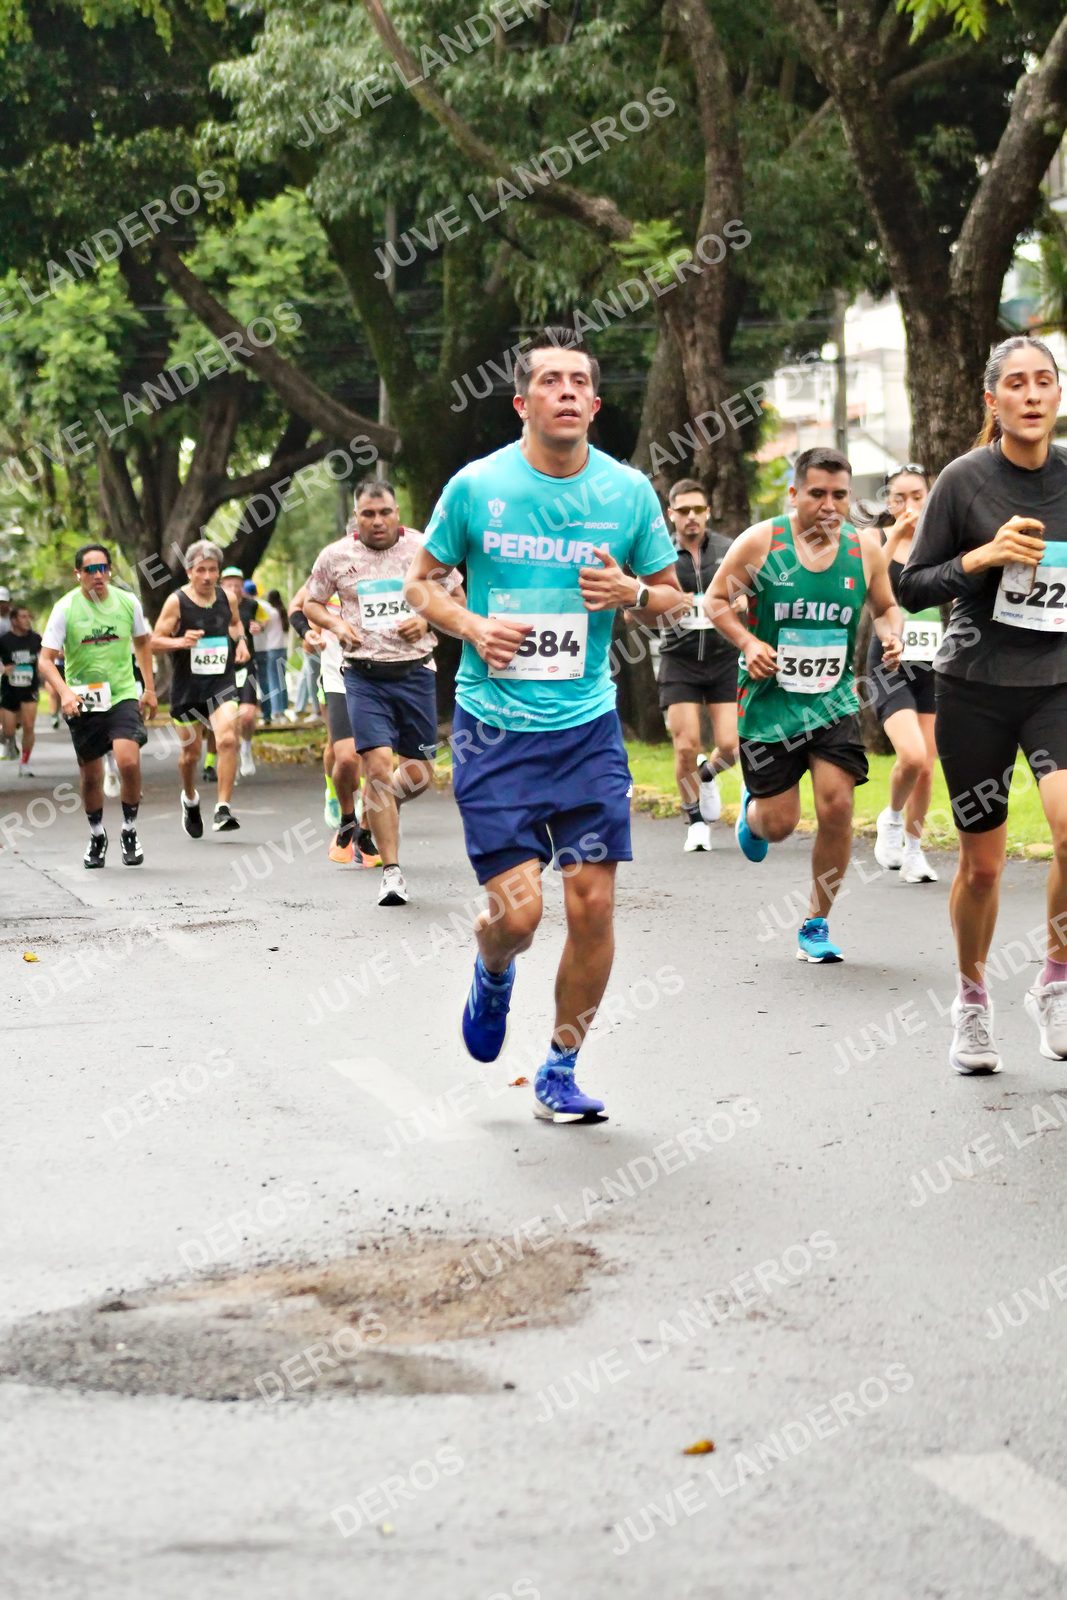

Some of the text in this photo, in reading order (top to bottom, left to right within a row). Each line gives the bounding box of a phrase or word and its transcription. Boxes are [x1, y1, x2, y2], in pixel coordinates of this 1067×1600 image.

[1005, 581, 1067, 609] 22
[363, 600, 411, 618] 3254
[774, 598, 853, 625] MÉXICO
[516, 630, 580, 658] 584
[906, 631, 937, 647] 851
[194, 653, 226, 666] 4826
[782, 657, 840, 677] 3673
